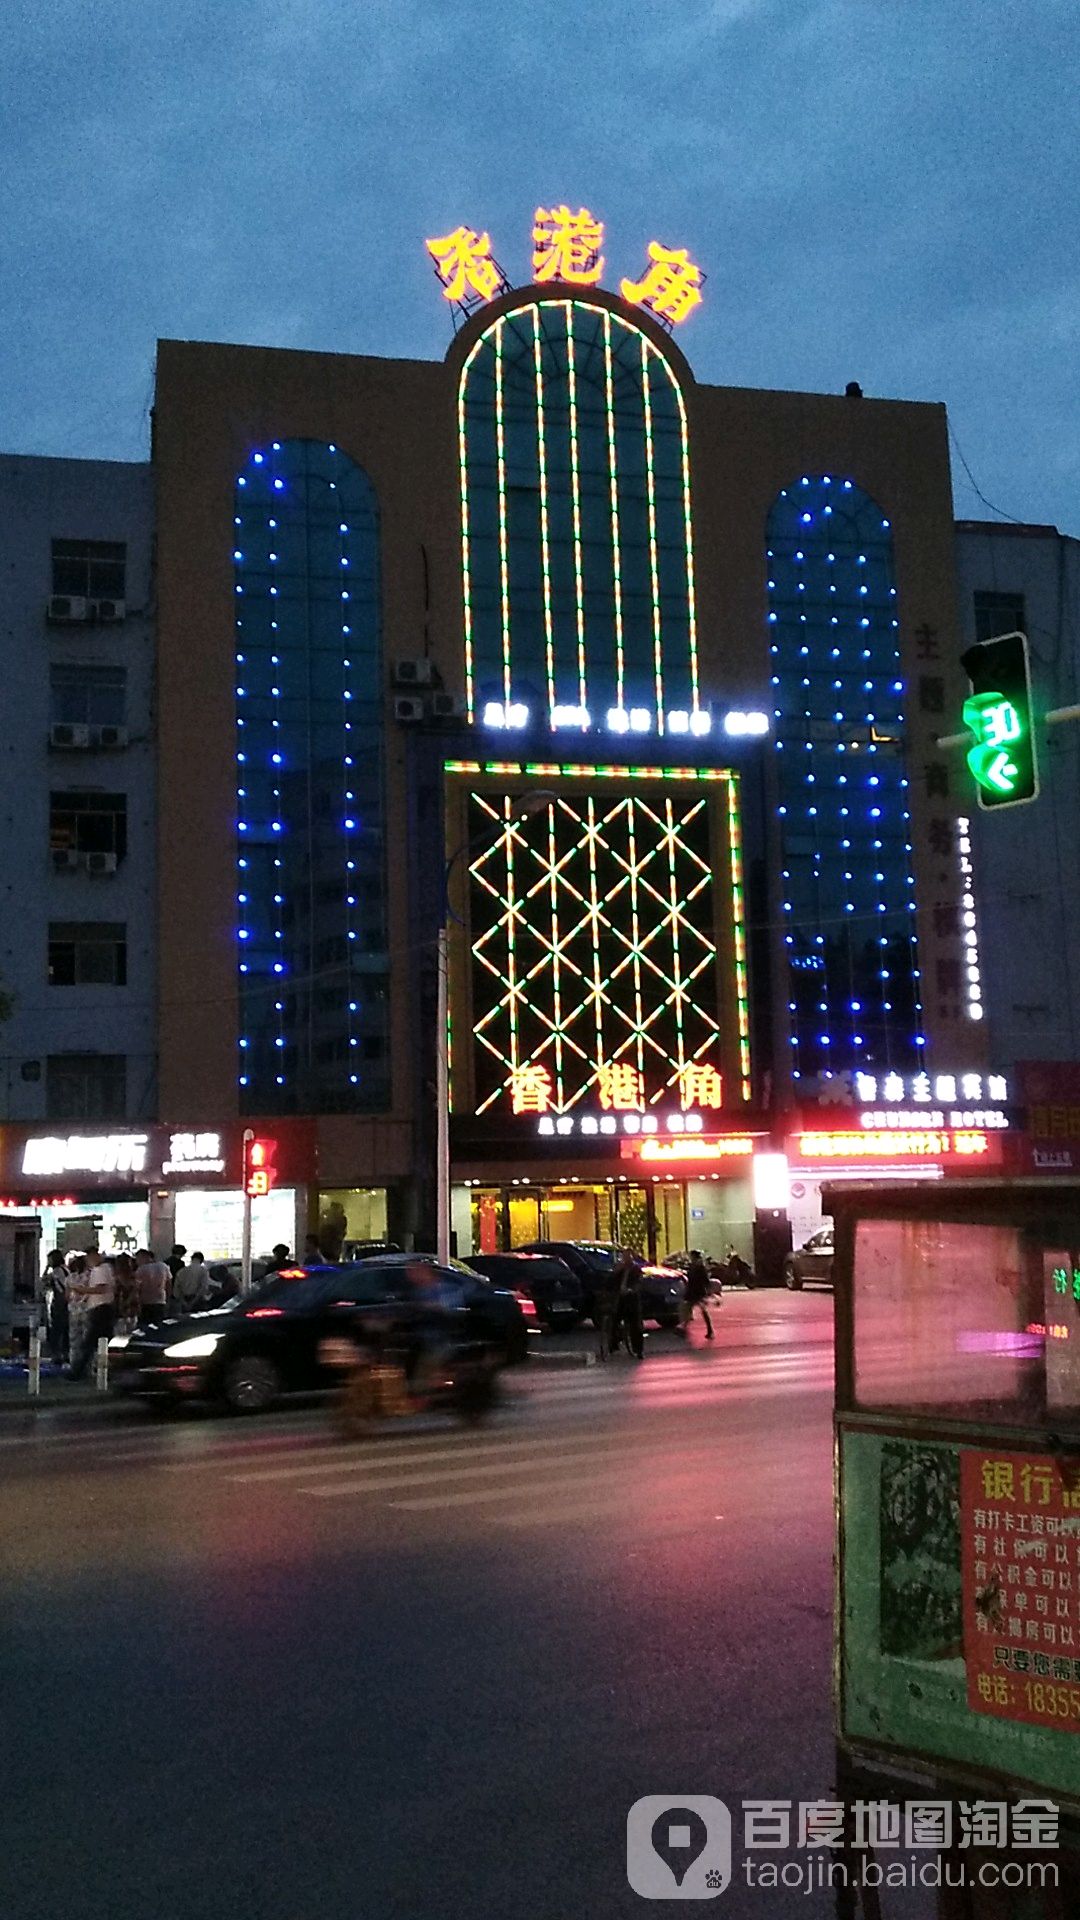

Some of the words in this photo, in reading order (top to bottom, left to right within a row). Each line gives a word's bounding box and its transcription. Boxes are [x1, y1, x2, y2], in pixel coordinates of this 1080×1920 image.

[425, 204, 704, 324] 香港角
[511, 1063, 722, 1115] 香港角
[973, 1507, 1080, 1540] 有打卡工资可以
[973, 1533, 1080, 1566] 有社保可以
[974, 1559, 1080, 1592] 有公积金可以
